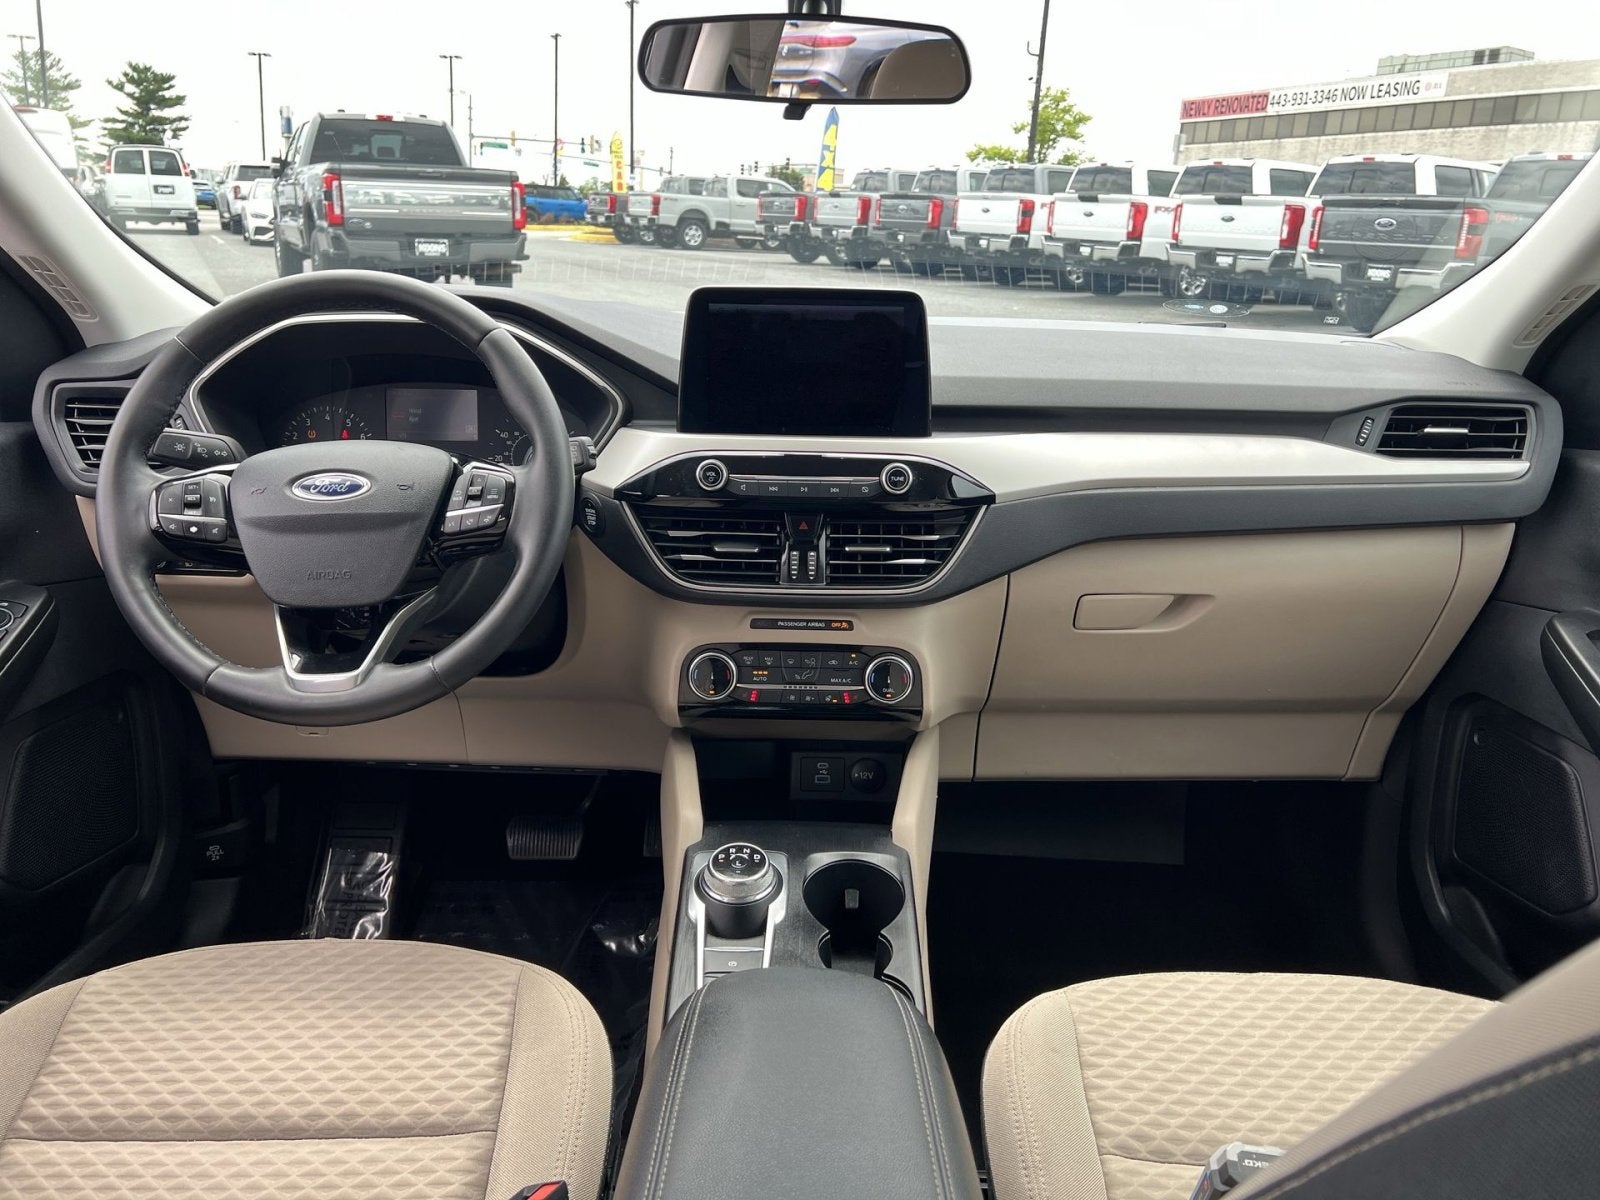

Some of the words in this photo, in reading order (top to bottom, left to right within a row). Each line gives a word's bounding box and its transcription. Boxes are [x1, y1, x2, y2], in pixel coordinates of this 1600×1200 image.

[1182, 100, 1213, 118] NEWLY
[1213, 94, 1269, 115] RENOVATED
[1269, 88, 1339, 108] 443-931-3346
[1340, 85, 1368, 102] NOW
[1370, 79, 1420, 99] LEASING
[346, 419, 352, 427] 5
[293, 432, 298, 440] 2
[500, 431, 509, 439] 40
[310, 478, 351, 493] Ford
[306, 569, 353, 581] AIRBAG
[859, 771, 875, 780] 12V
